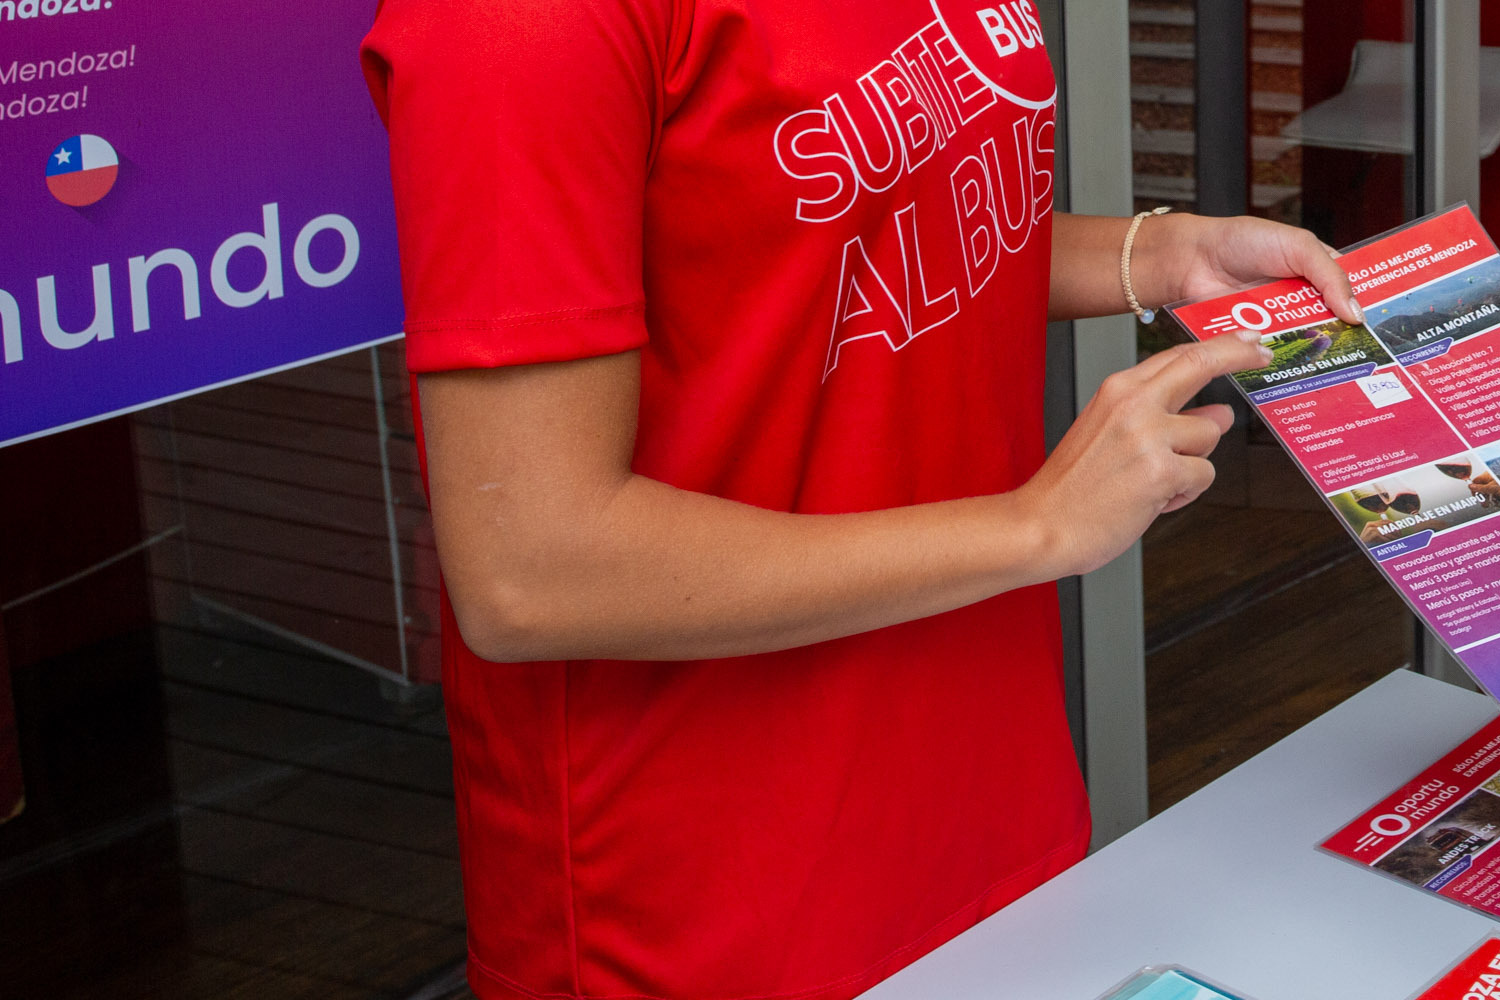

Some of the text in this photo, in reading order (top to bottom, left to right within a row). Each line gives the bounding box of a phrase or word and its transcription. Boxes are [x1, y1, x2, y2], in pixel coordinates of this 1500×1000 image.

[0, 45, 136, 86] Mendoza!
[773, 20, 998, 223] SUBITE
[822, 108, 1056, 385] AL BUS
[1416, 257, 1431, 268] DE
[1429, 239, 1477, 263] MENDOZA
[1348, 244, 1432, 282] ÓLO LAS MEJORES
[0, 202, 361, 364] undo
[1274, 299, 1327, 323] mund
[1417, 303, 1500, 342] ALTA MONTAÑA
[1262, 349, 1367, 383] BODEGAS EN MAIPÚ
[1438, 354, 1473, 371] Nacional
[1471, 350, 1488, 359] Nro.
[1428, 362, 1488, 386] Dique Potrerillos
[1254, 384, 1303, 402] RECORREMOS
[1435, 384, 1456, 394] Valle
[1440, 388, 1477, 404] Cordillera
[1273, 400, 1317, 416] Don Arturo
[1281, 411, 1316, 424] Cecchin
[1449, 402, 1468, 411] Villa
[1457, 408, 1485, 420] Puente
[1484, 402, 1498, 411] del
[1295, 426, 1345, 444] Dominicana
[1355, 412, 1396, 427] Barrancas
[1465, 416, 1494, 429] Mirador
[1472, 429, 1491, 438] Villa
[1302, 437, 1344, 453] Vistandes
[1377, 492, 1486, 535] MARIDAJE EN MAIPÚ
[1377, 542, 1408, 556] ANTIGAL
[1393, 553, 1435, 571] Innovador
[1434, 538, 1480, 557] restaurante
[1479, 533, 1496, 543] que
[1402, 561, 1448, 581] enoturismo
[1446, 559, 1454, 567] y
[1409, 577, 1435, 591] Menú
[1433, 575, 1442, 583] 3
[1441, 567, 1468, 583] pasos
[1419, 589, 1441, 600] casa
[1426, 597, 1452, 610] Menú
[1450, 594, 1459, 602] 6
[1458, 586, 1485, 601] pasos
[1452, 758, 1474, 773] SÓLO
[1471, 749, 1487, 760] LAS
[1394, 779, 1444, 813] oportu
[1409, 785, 1460, 820] mundo
[1438, 823, 1496, 864] ANDES TRUCK
